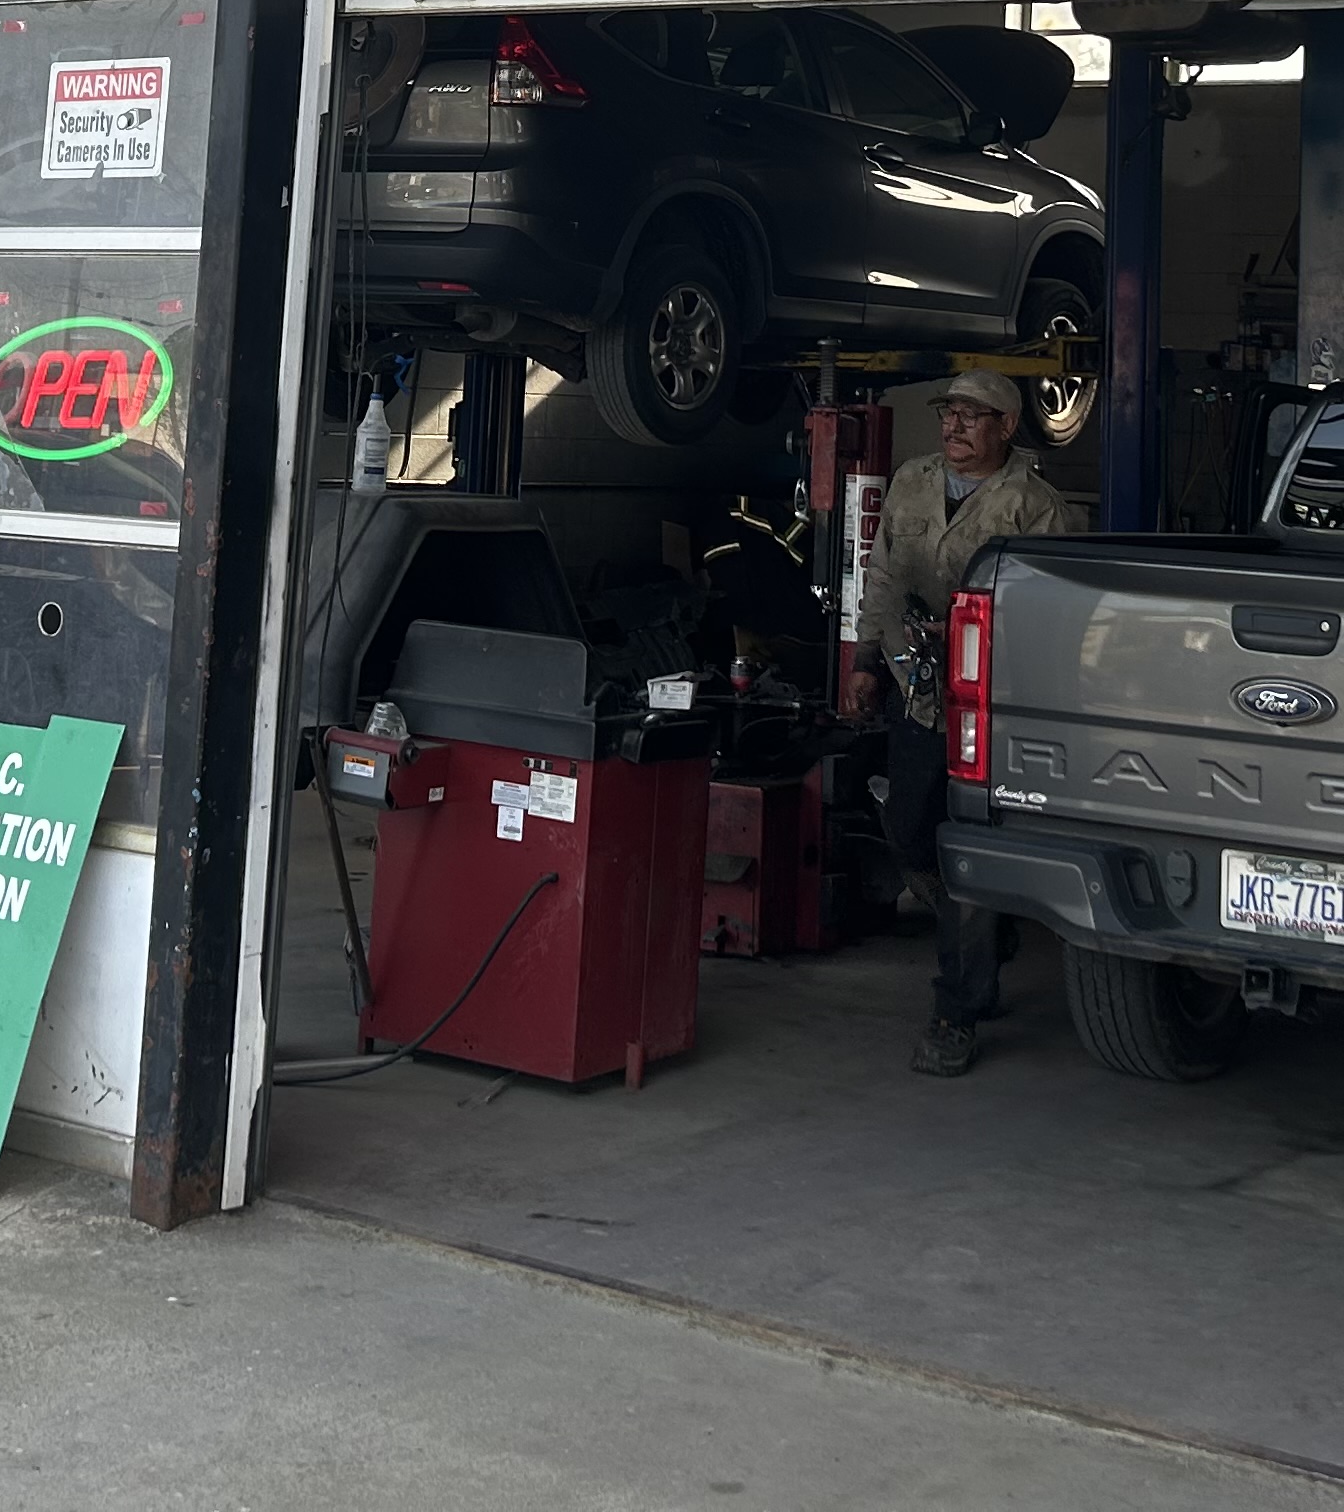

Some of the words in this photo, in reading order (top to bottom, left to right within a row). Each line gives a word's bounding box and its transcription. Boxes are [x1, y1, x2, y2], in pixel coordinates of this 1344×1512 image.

[62, 71, 157, 99] WARNING
[59, 109, 114, 137] Security
[57, 139, 110, 163] Cameras
[112, 137, 125, 161] In
[128, 137, 151, 161] Use
[1255, 690, 1299, 713] Ford
